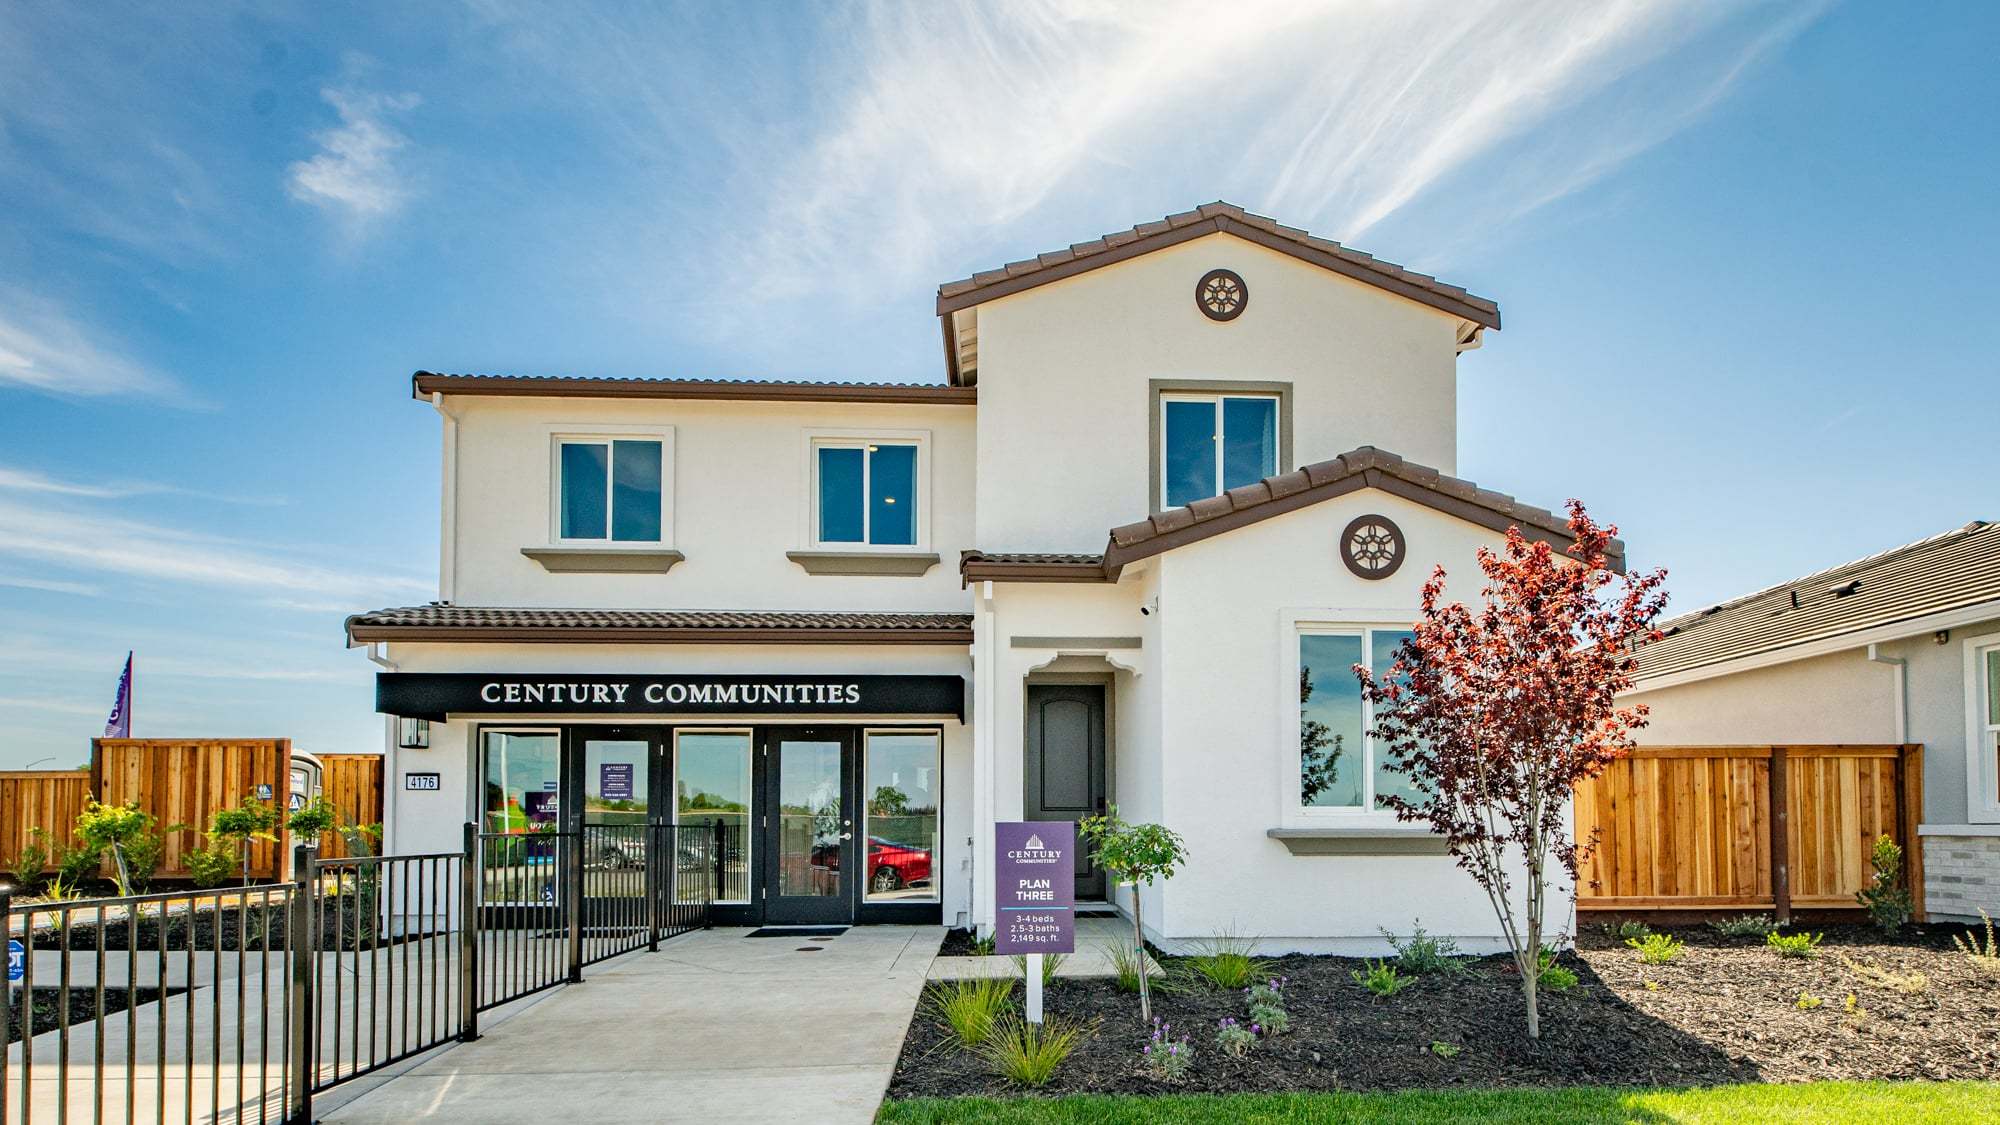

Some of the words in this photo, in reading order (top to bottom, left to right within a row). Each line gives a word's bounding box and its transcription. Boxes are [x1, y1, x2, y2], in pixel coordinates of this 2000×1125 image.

[480, 682, 630, 704] CENTURY
[644, 683, 861, 704] COMMUNITIES
[410, 776, 435, 788] 4176
[1008, 850, 1062, 859] CENTURY
[1019, 879, 1051, 889] PLAN
[1015, 890, 1054, 901] THREE
[1016, 915, 1031, 923] 3-4
[1032, 914, 1055, 923] beds
[1010, 924, 1034, 933] 2.5-3
[1035, 924, 1060, 933] baths
[1011, 934, 1034, 943] 2,149
[1035, 935, 1049, 943] sq.
[1050, 934, 1060, 942] ft.
